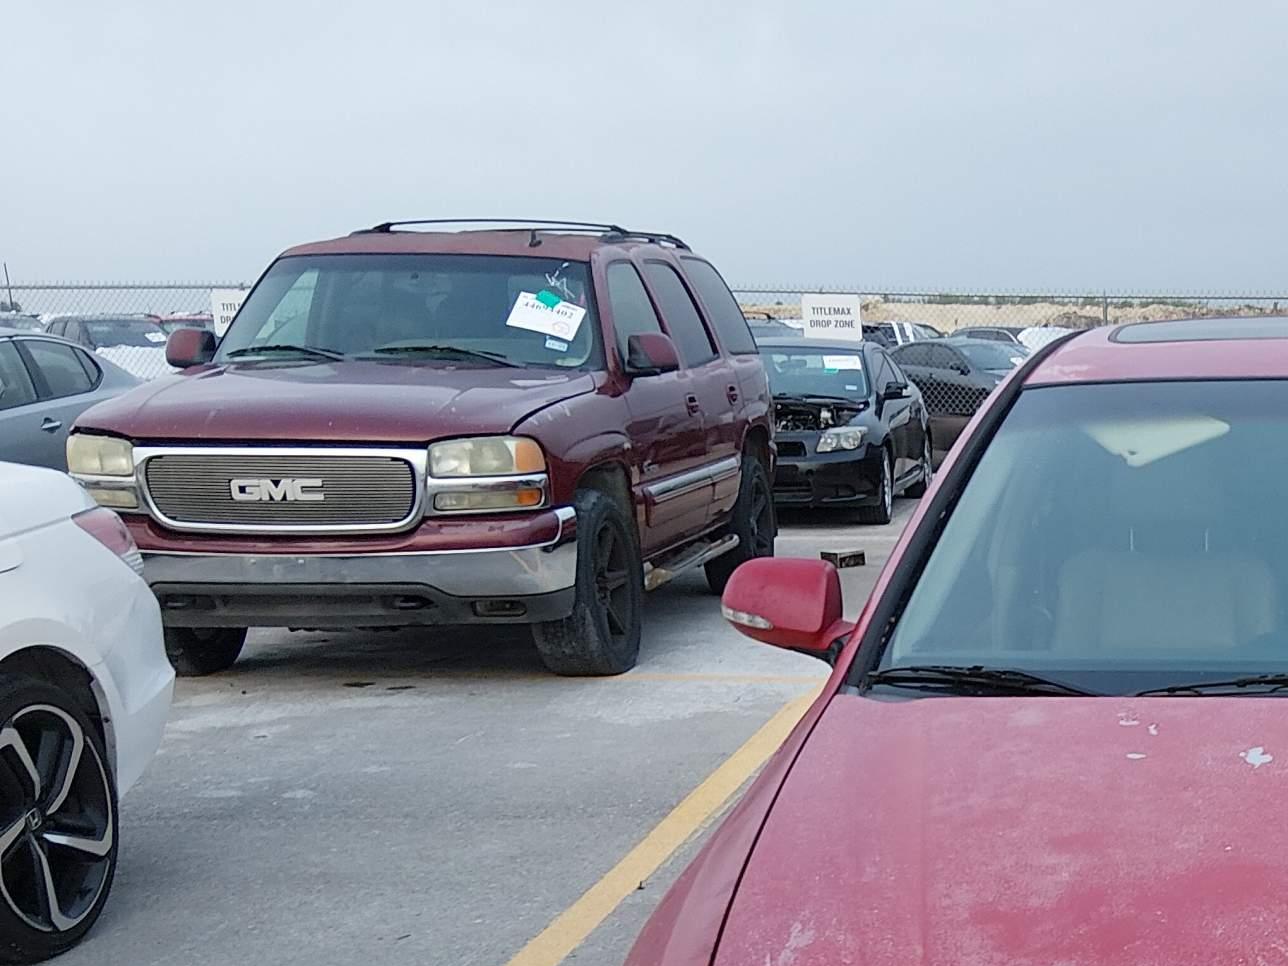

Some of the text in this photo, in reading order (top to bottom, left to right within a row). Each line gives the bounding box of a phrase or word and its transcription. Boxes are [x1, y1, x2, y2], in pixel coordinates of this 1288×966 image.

[811, 306, 852, 316] TITLEMAX
[809, 319, 855, 329] DROP ZONE
[229, 478, 325, 501] GMC
